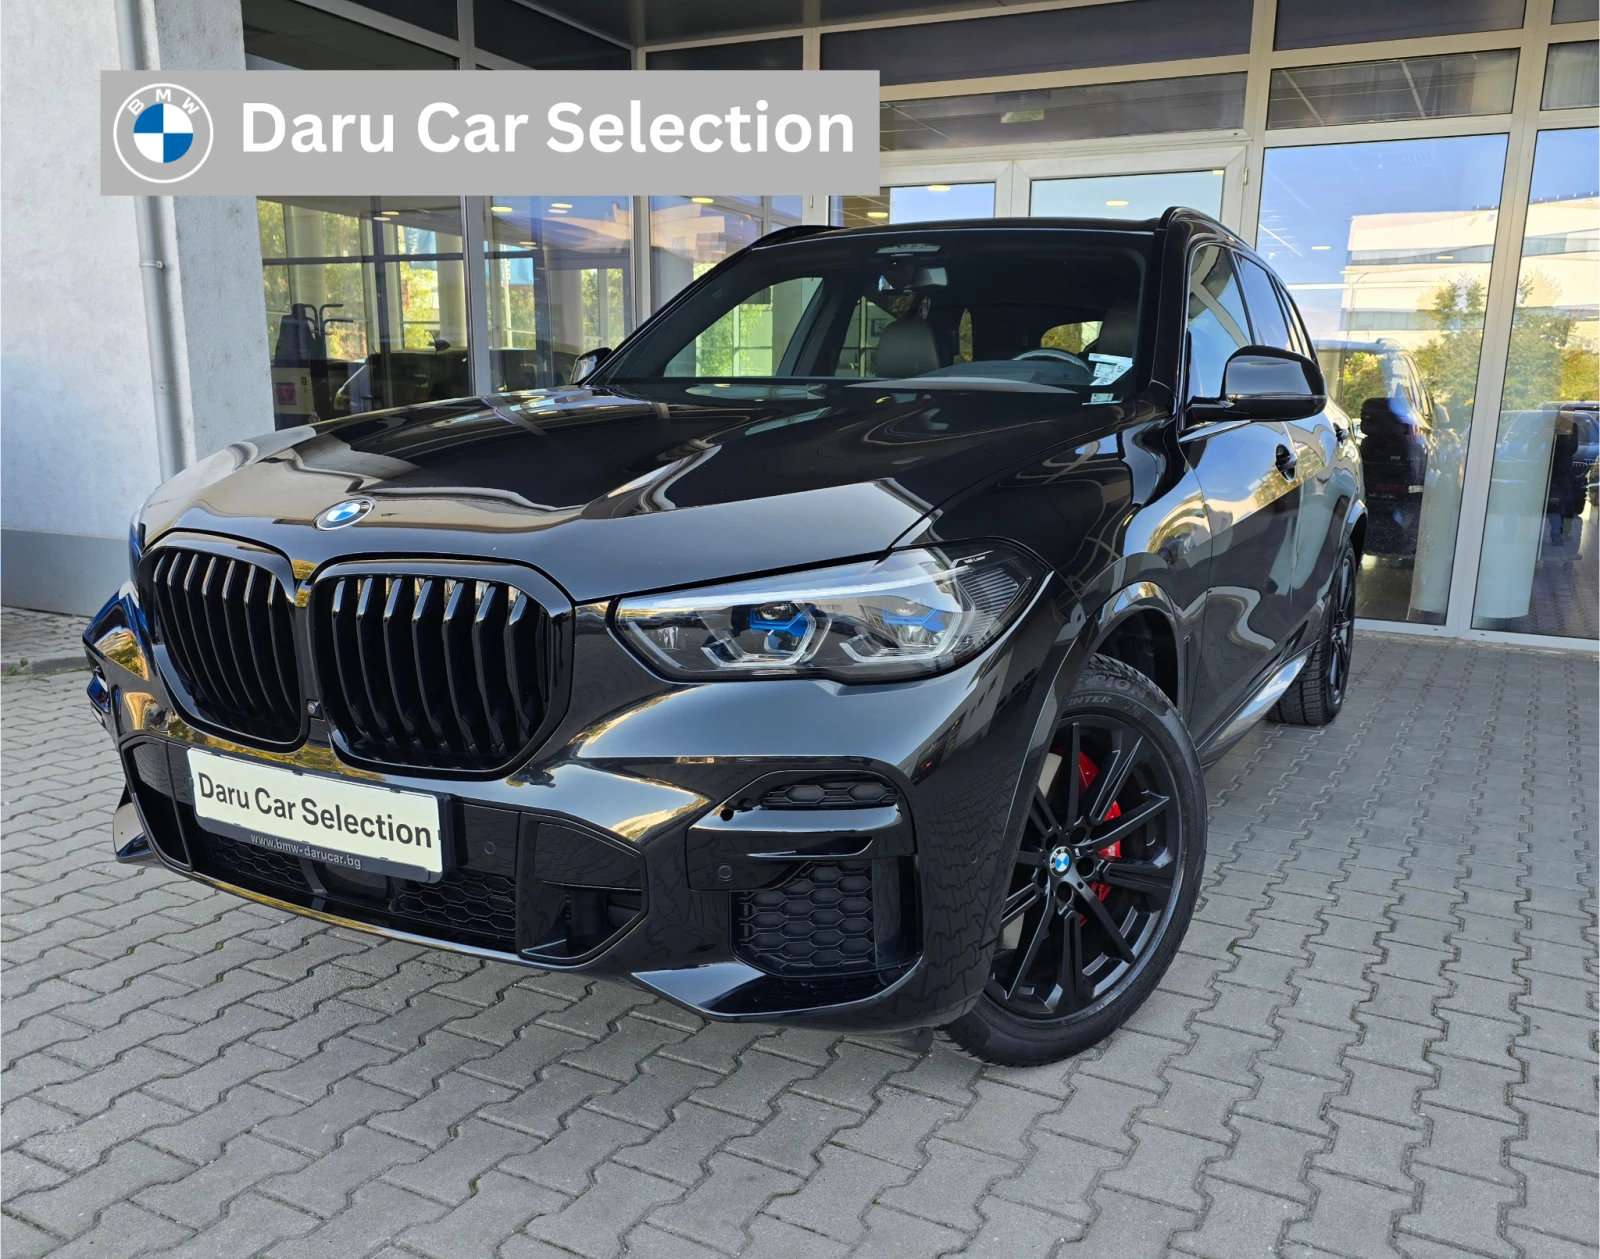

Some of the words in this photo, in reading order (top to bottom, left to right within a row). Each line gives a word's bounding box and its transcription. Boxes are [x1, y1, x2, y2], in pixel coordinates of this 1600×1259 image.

[1067, 695, 1112, 707] INTER
[198, 772, 250, 810] Daru
[254, 787, 297, 820] Car
[301, 797, 433, 849] Selection
[250, 834, 362, 870] www.bmw-darucar.bg
